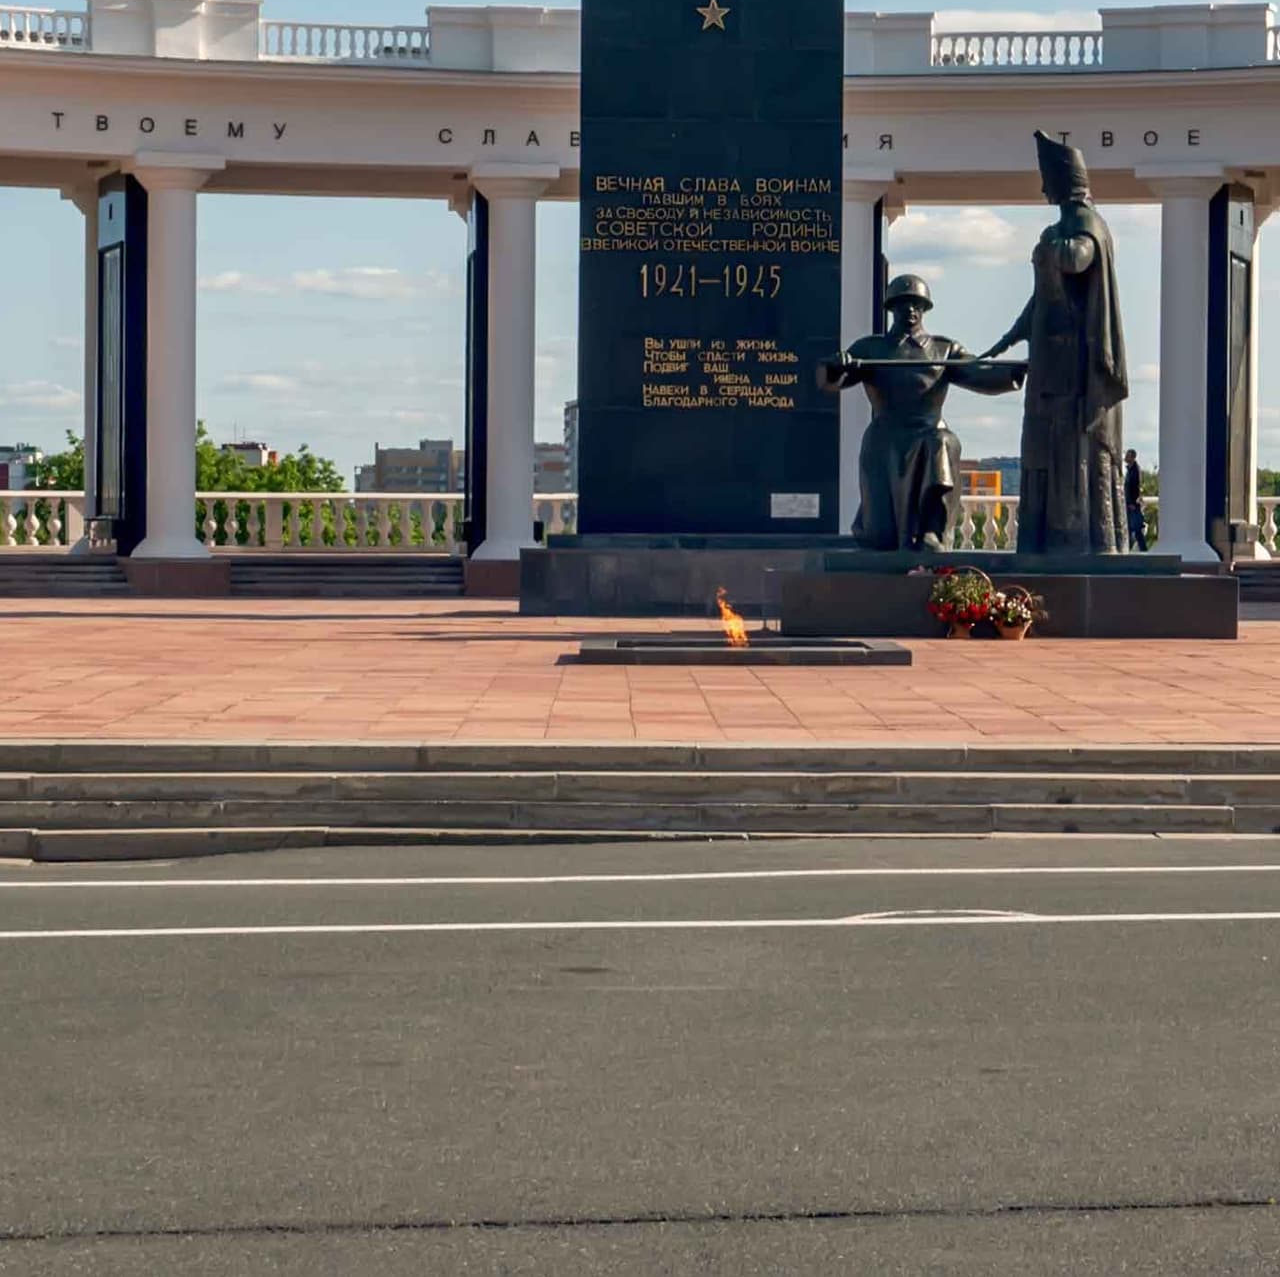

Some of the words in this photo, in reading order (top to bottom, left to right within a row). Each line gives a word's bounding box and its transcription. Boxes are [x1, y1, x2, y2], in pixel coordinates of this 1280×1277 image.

[51, 112, 287, 140] ТВОЕМУ
[1058, 130, 1201, 147] ТВОЕ
[596, 176, 665, 192] ВЕЧНАЯ
[679, 177, 741, 193] СЛАВА
[755, 177, 831, 194] ВОИНАМ
[642, 193, 704, 207] ПАВШИМ
[718, 194, 727, 207] В
[740, 194, 783, 207] БОЯХ
[596, 207, 613, 220] ЗА
[616, 206, 685, 221] СВОБОДУ
[703, 208, 832, 222] НЕЗАВИСИМОСТЬ
[752, 222, 833, 239] РОДИНЫ
[669, 339, 701, 350] УШЛИ
[697, 351, 746, 362] СПАСТИ
[757, 351, 799, 363] ЖИЗНЬ
[703, 363, 729, 374] ВАШ
[714, 374, 751, 384] ИМЕНА
[765, 374, 798, 385] ВАШИ
[700, 385, 708, 396] В
[719, 385, 773, 396] СЕРДЦАХ
[748, 395, 795, 408] НАРОДА
